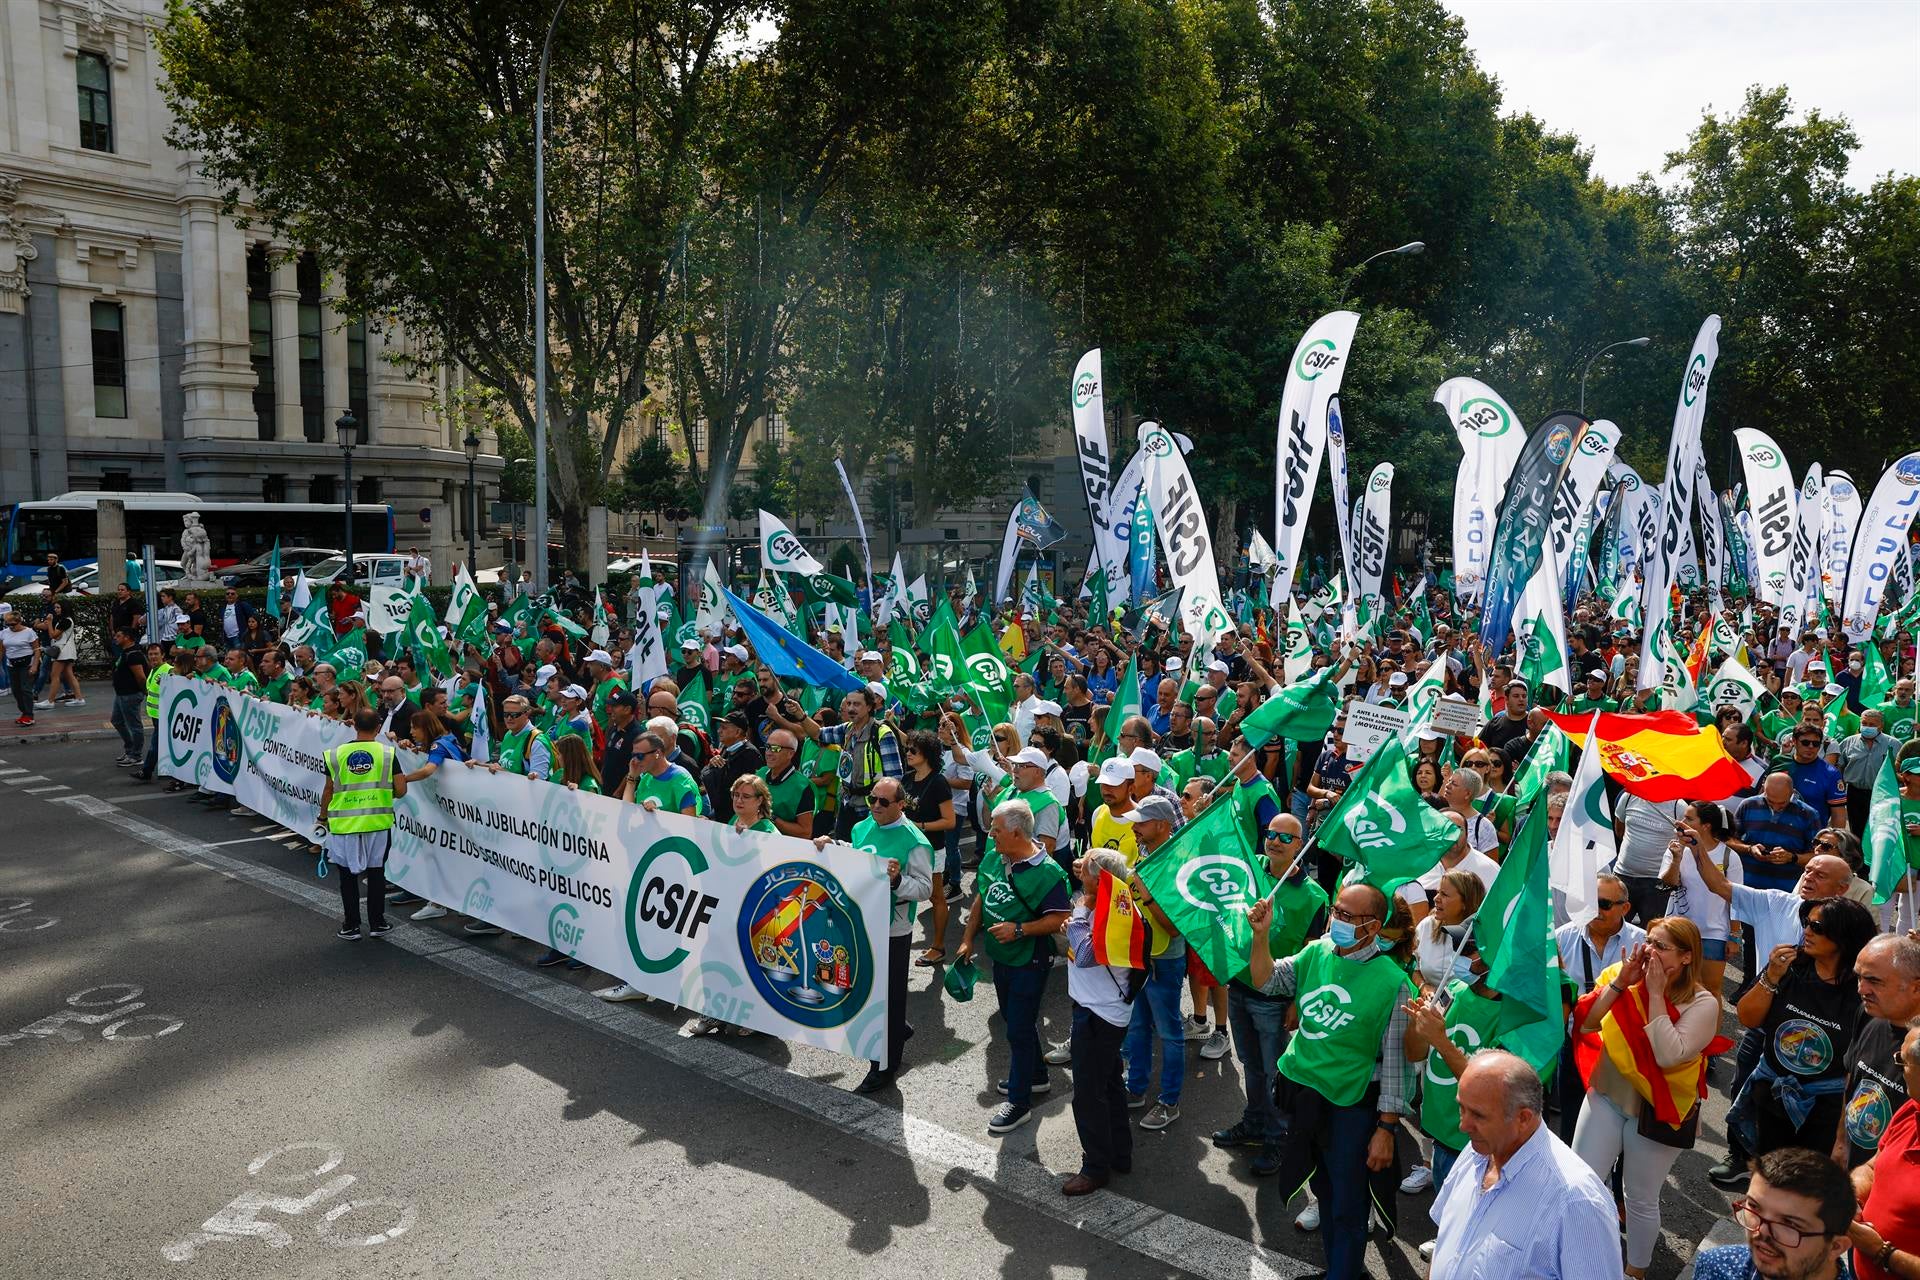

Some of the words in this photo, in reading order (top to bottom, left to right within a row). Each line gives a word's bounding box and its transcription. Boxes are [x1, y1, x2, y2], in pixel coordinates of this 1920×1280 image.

[1305, 351, 1340, 370] CSIF
[1077, 382, 1098, 397] CSIF
[1584, 436, 1609, 454] CSIF
[1078, 434, 1110, 531] CSIF
[1374, 477, 1390, 488] CSIF
[1806, 481, 1819, 497] CSIF
[1362, 508, 1386, 577] CSIF
[1790, 515, 1812, 592] CSIF
[976, 661, 1005, 693] CSIF
[1283, 696, 1309, 711] Madrid
[172, 712, 203, 744] CSIF
[244, 706, 281, 742] CSIF
[459, 803, 483, 825] UNA
[486, 811, 559, 849] JUBILACIÓN
[563, 832, 610, 863] DIGNA
[399, 813, 436, 845] CALIDAD
[440, 829, 457, 850] DE
[459, 836, 479, 859] LOS
[481, 844, 536, 884] SERVICIOS
[539, 866, 612, 908] PÚBLICOS
[764, 866, 846, 907] JUSAPOL
[640, 876, 720, 940] CSIF
[554, 919, 585, 946] CSIF
[1304, 999, 1355, 1030] CSIF
